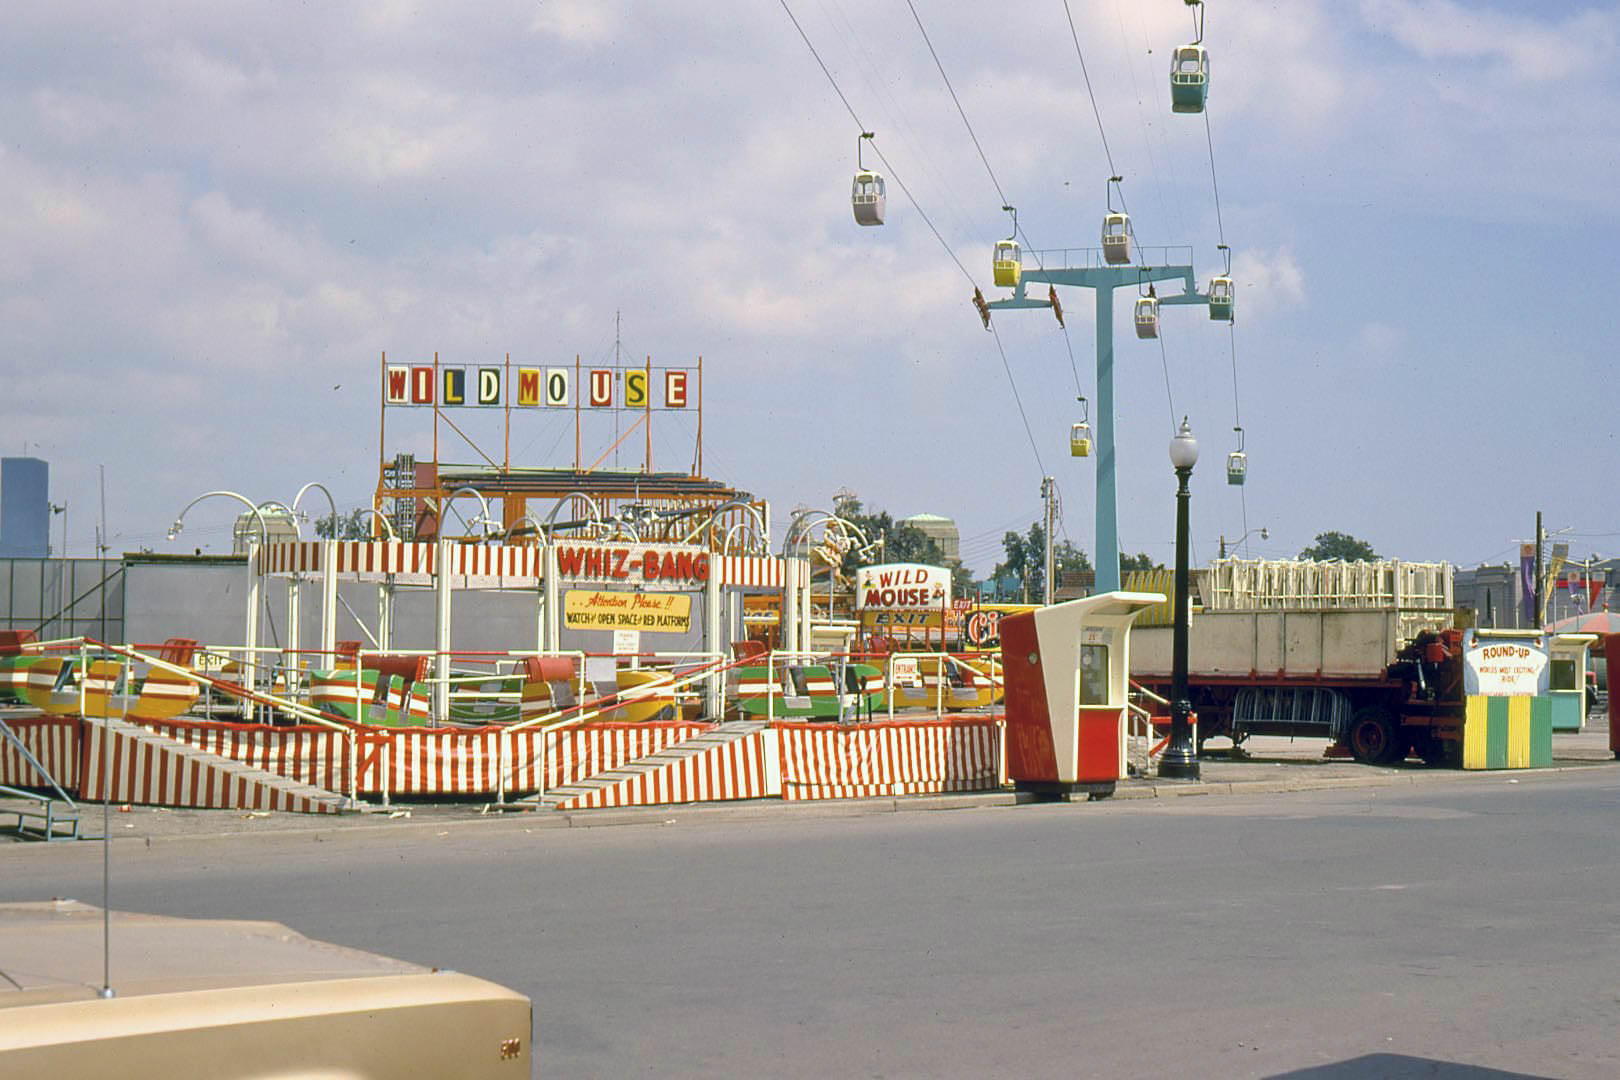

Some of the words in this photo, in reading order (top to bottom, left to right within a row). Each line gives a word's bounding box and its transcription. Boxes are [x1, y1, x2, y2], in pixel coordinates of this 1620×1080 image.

[389, 370, 498, 403] WILD
[520, 370, 686, 405] MOUSE
[556, 546, 710, 581] WHIZ-BANG
[879, 568, 929, 588] WILD
[864, 588, 929, 607] MOUSE
[953, 599, 972, 609] EXIT
[566, 612, 590, 624] WATCH
[598, 613, 615, 625] OPEN
[617, 614, 638, 626] SPACE
[643, 615, 656, 626] RED
[656, 615, 690, 627] PLATFORMS
[875, 613, 929, 624] EXIT
[1482, 646, 1531, 661] ROUND-UP
